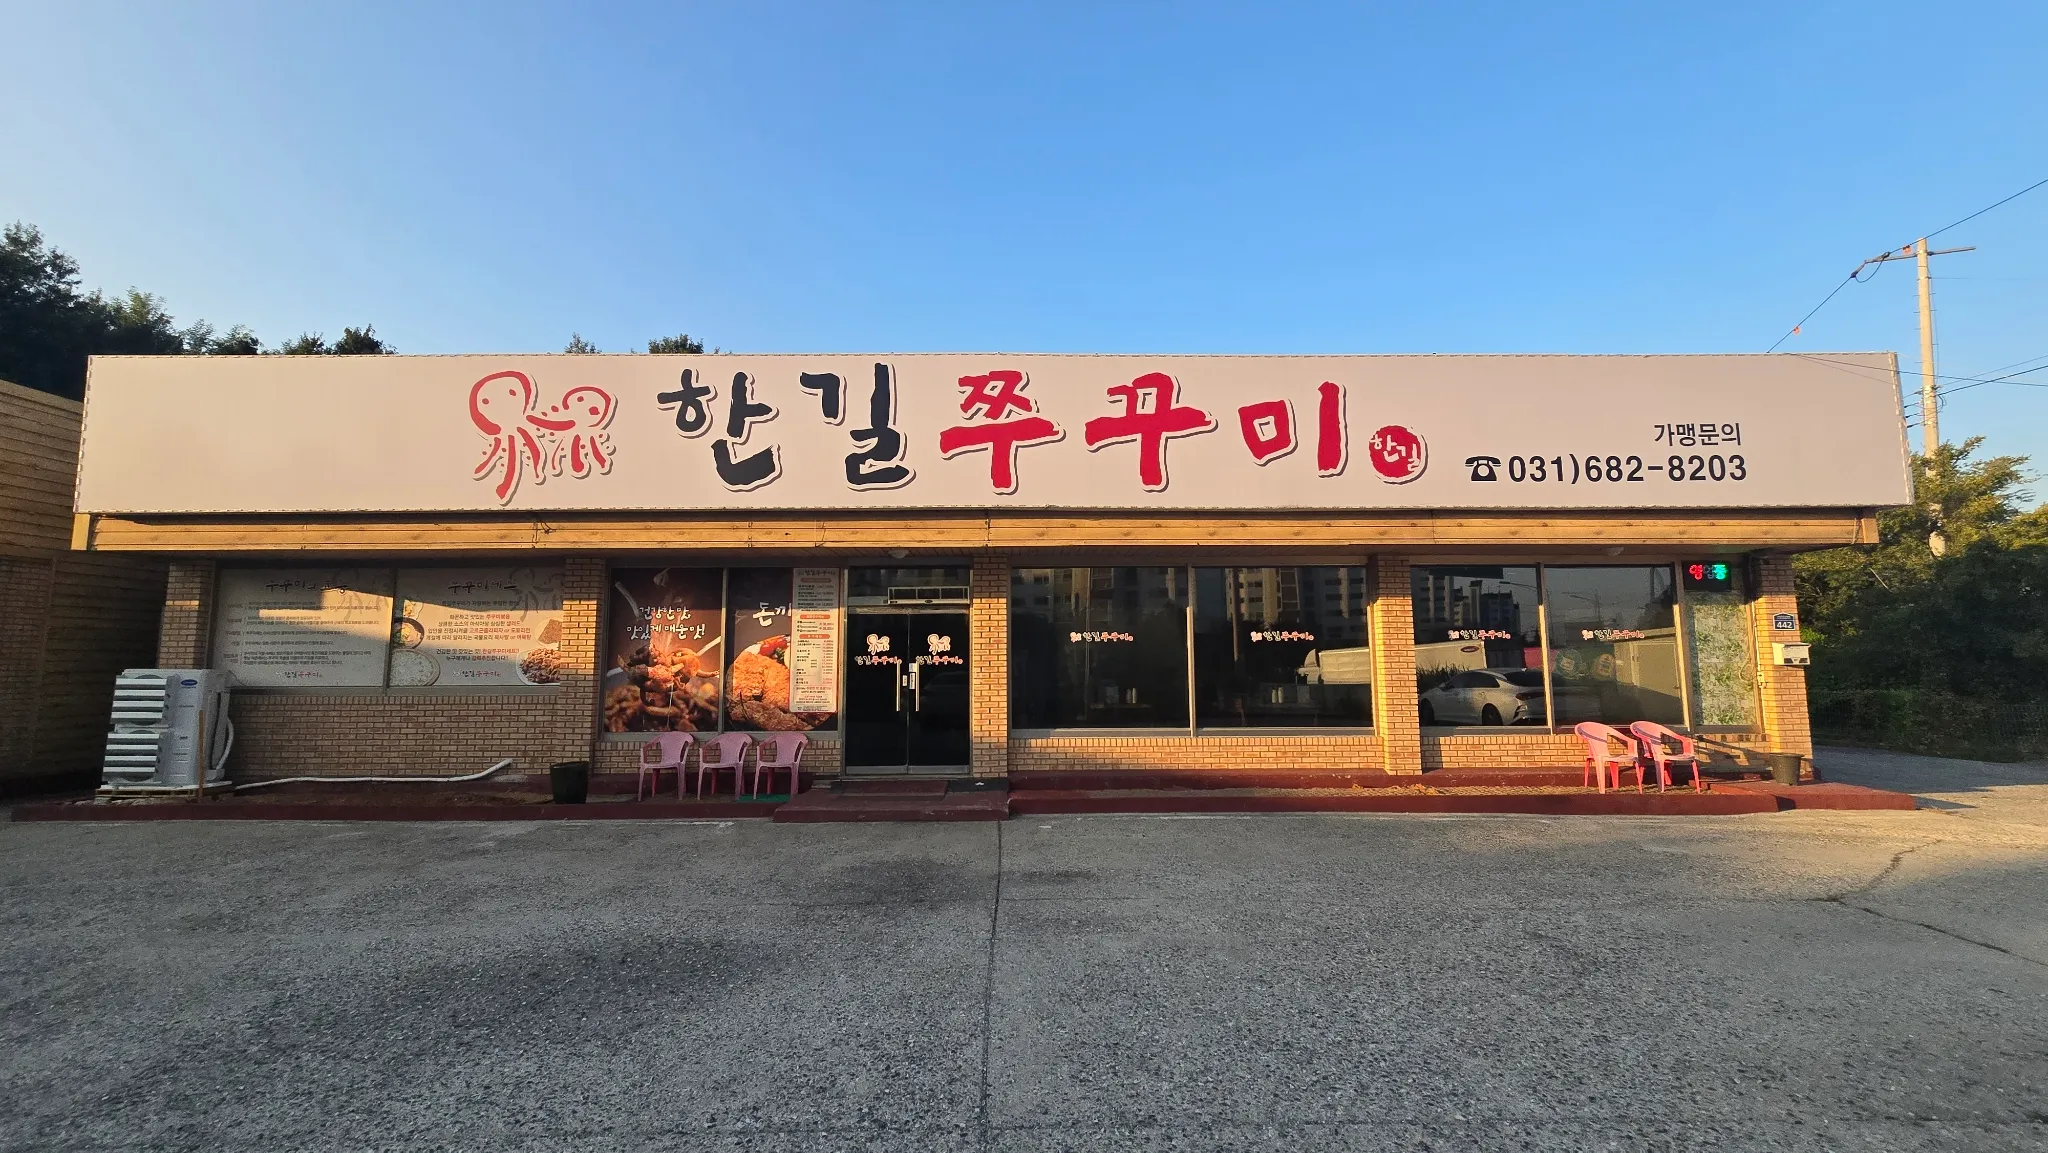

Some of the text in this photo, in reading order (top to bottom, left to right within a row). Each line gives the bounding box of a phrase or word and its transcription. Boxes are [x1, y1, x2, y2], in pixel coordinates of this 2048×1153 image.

[1653, 422, 1742, 446] 가맹문의
[1369, 433, 1420, 472] 한길
[1508, 453, 1747, 484] 031)682-8203
[639, 605, 675, 620] 건강한
[626, 624, 662, 640] 맛있게
[664, 624, 688, 640] 매운
[1776, 621, 1793, 629] 442
